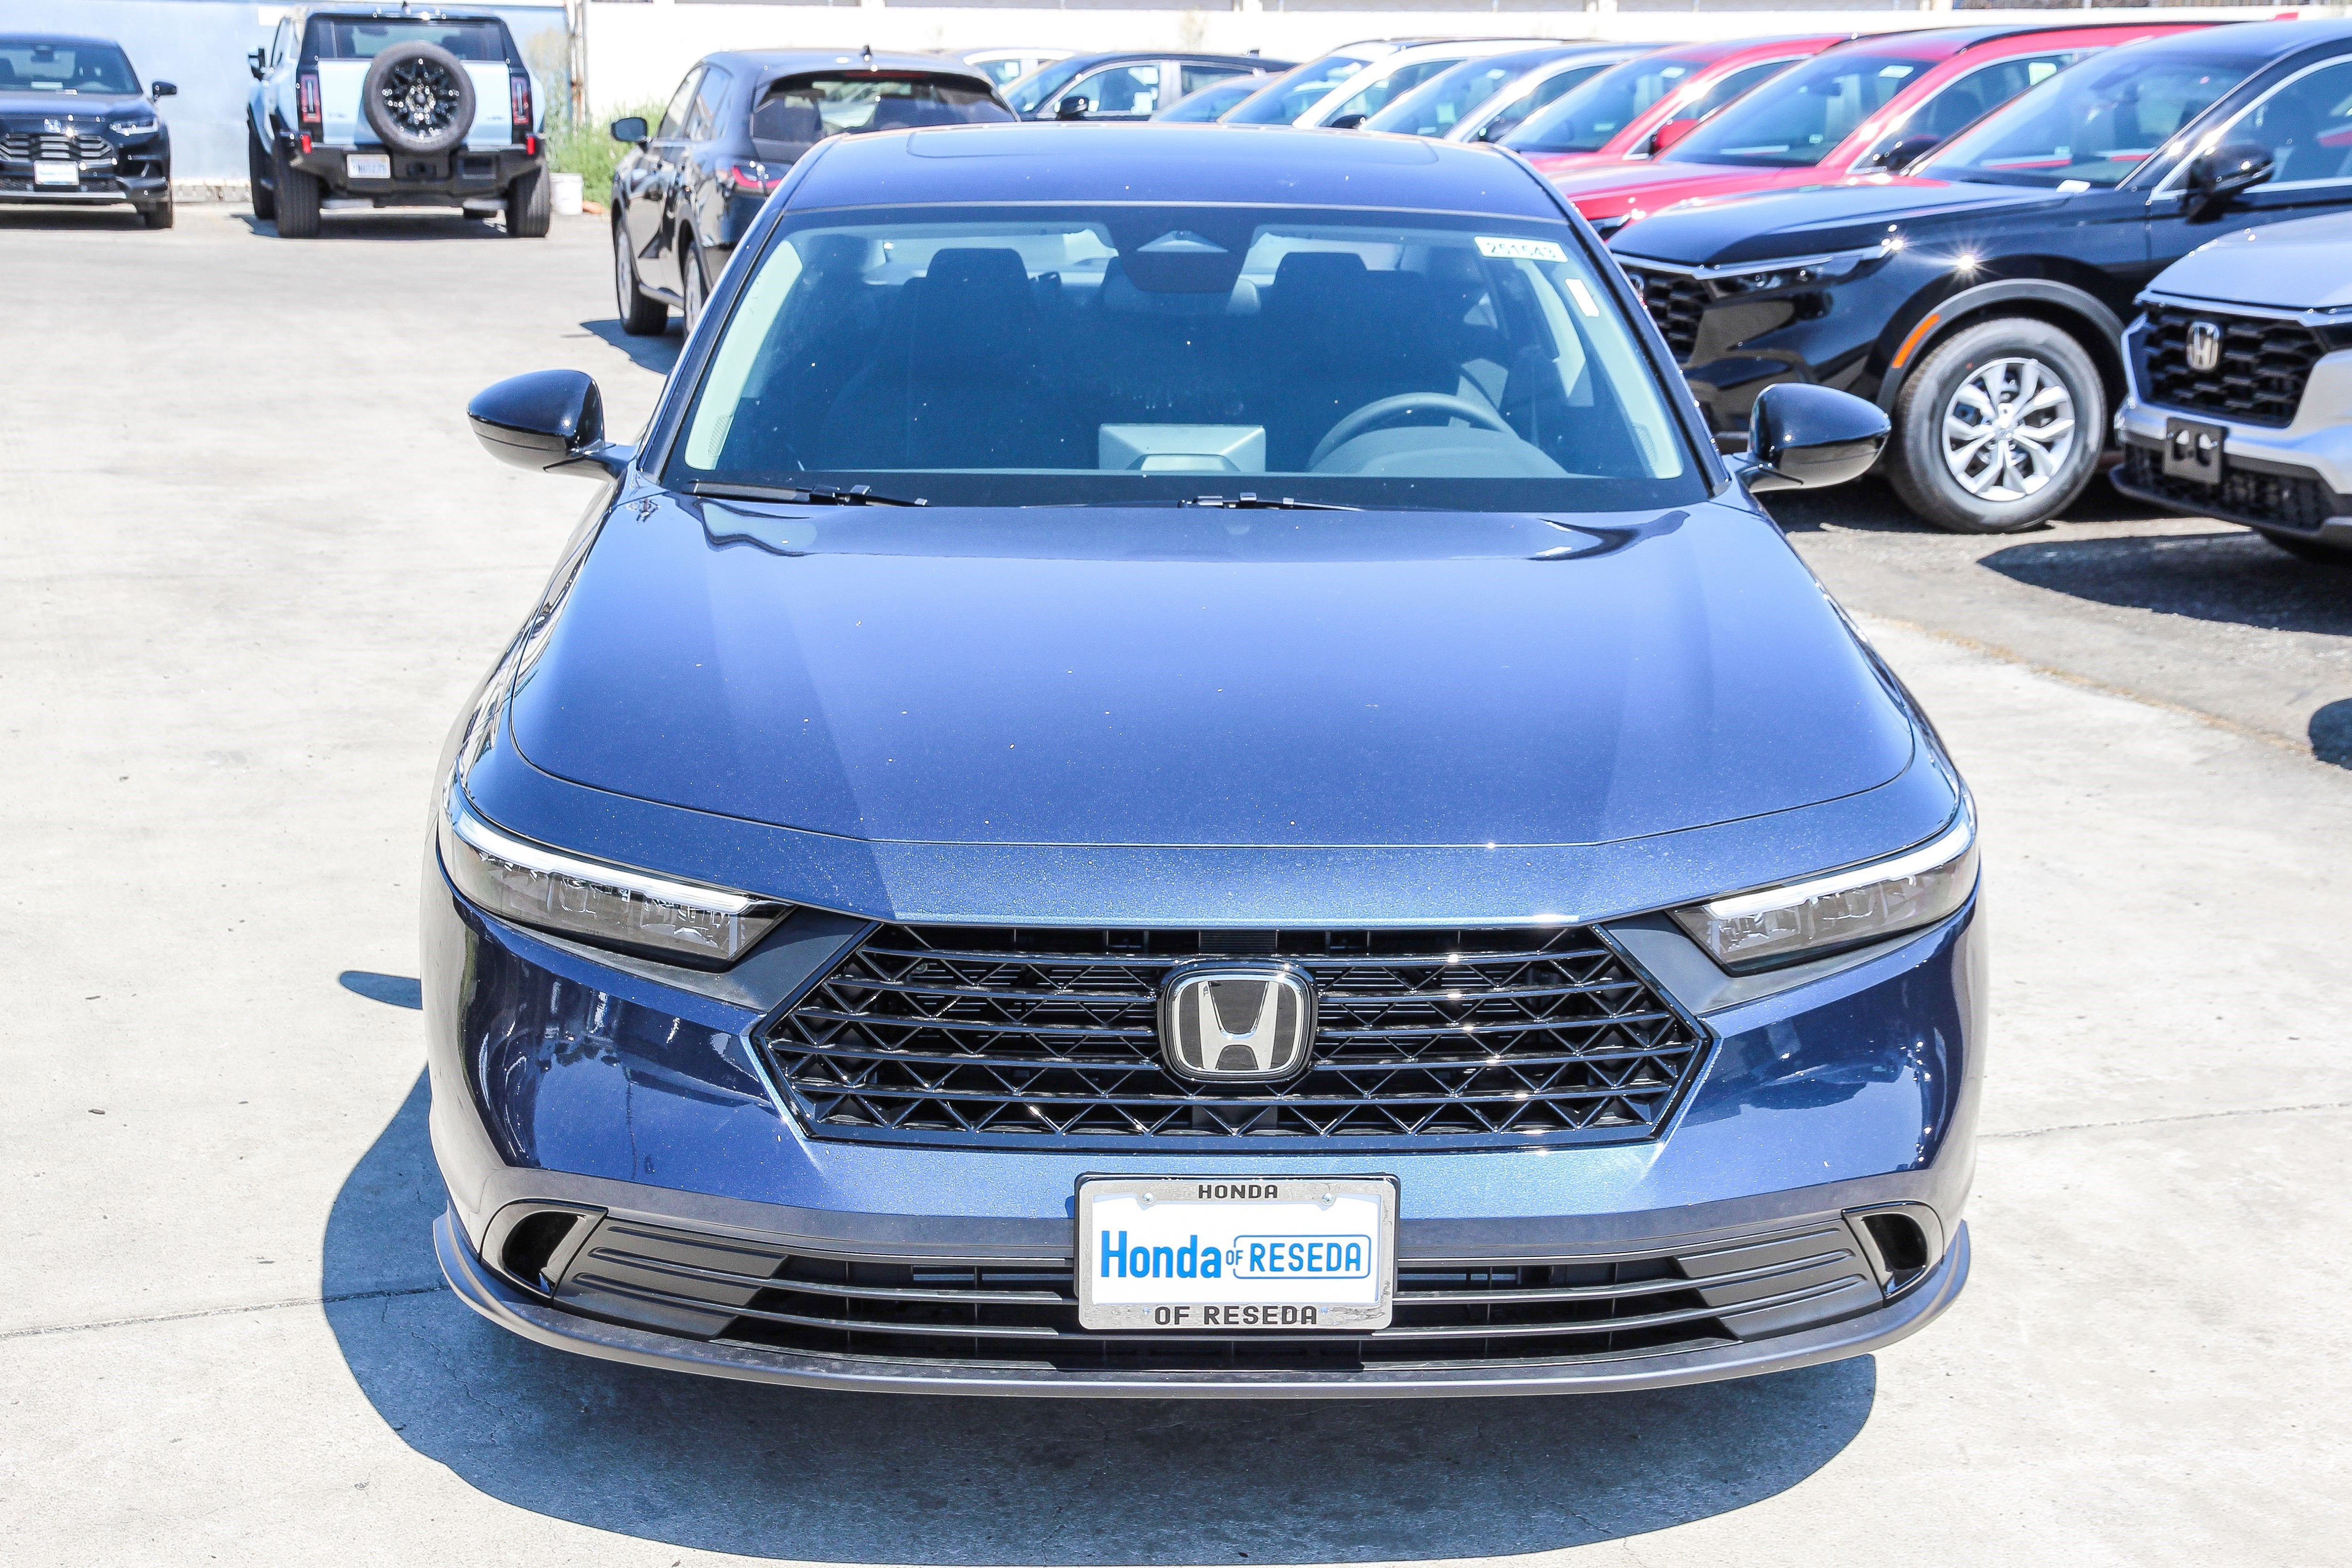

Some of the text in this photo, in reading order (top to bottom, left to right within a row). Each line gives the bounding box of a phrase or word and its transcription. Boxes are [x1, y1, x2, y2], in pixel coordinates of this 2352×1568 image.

[1198, 1184, 1278, 1199] HONDA
[1101, 1230, 1361, 1279] Honda OF RESEDA
[1154, 1305, 1317, 1325] OF RESEDA
